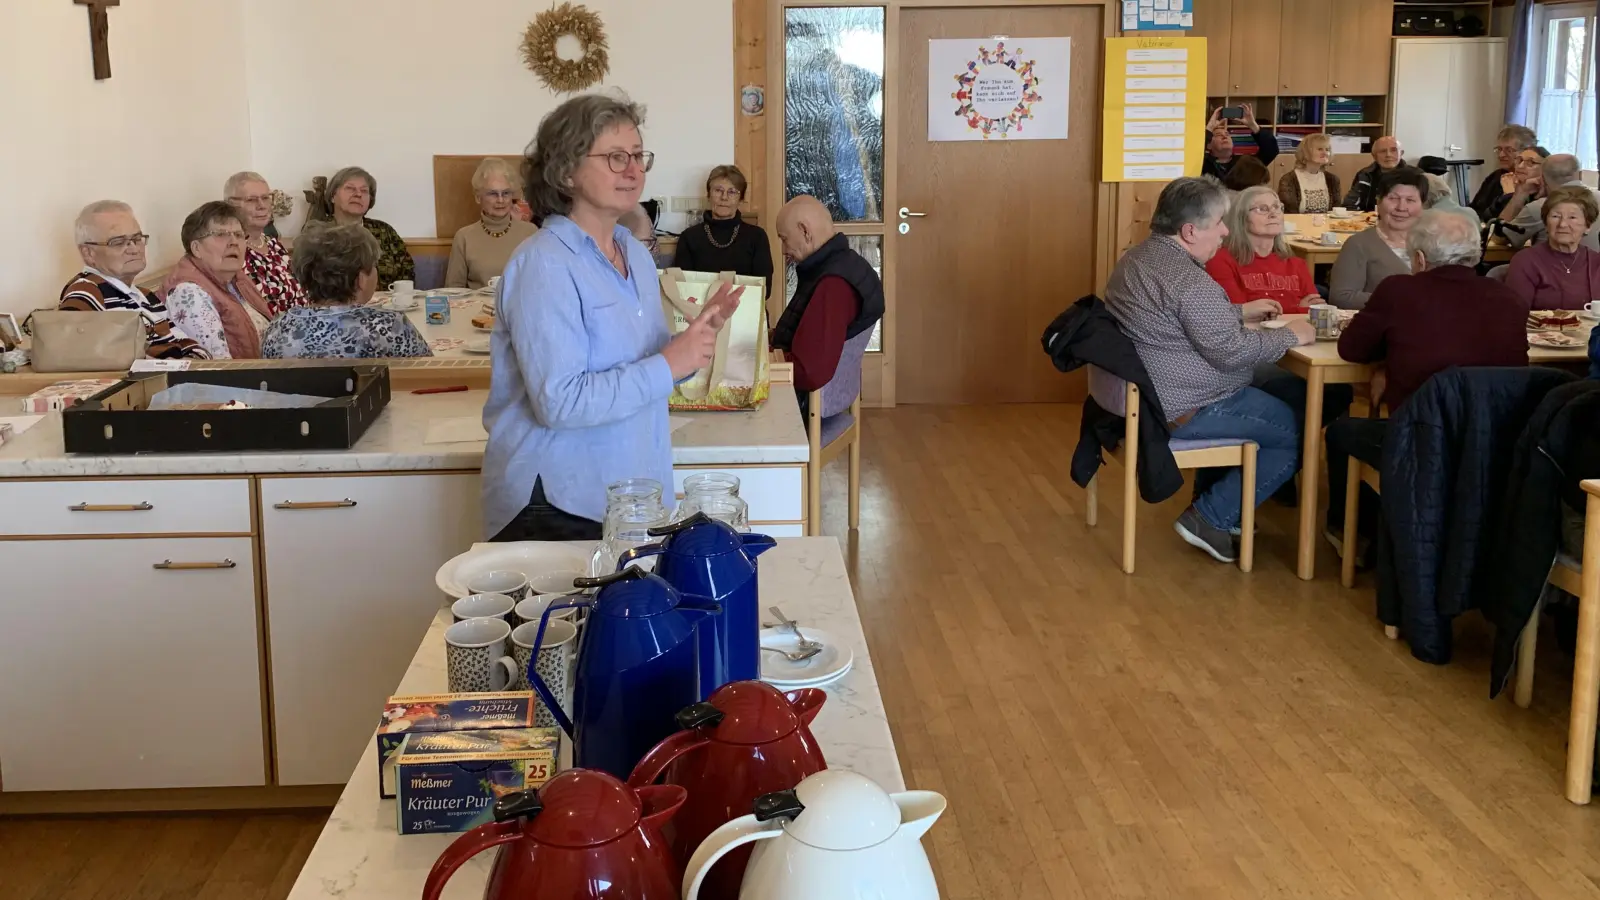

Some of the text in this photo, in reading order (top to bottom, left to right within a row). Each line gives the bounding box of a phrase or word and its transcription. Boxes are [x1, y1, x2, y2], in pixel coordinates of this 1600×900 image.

[528, 764, 547, 779] 25
[410, 778, 453, 788] Meßmer
[408, 795, 492, 810] Kräuter Pur
[412, 821, 423, 830] 25
